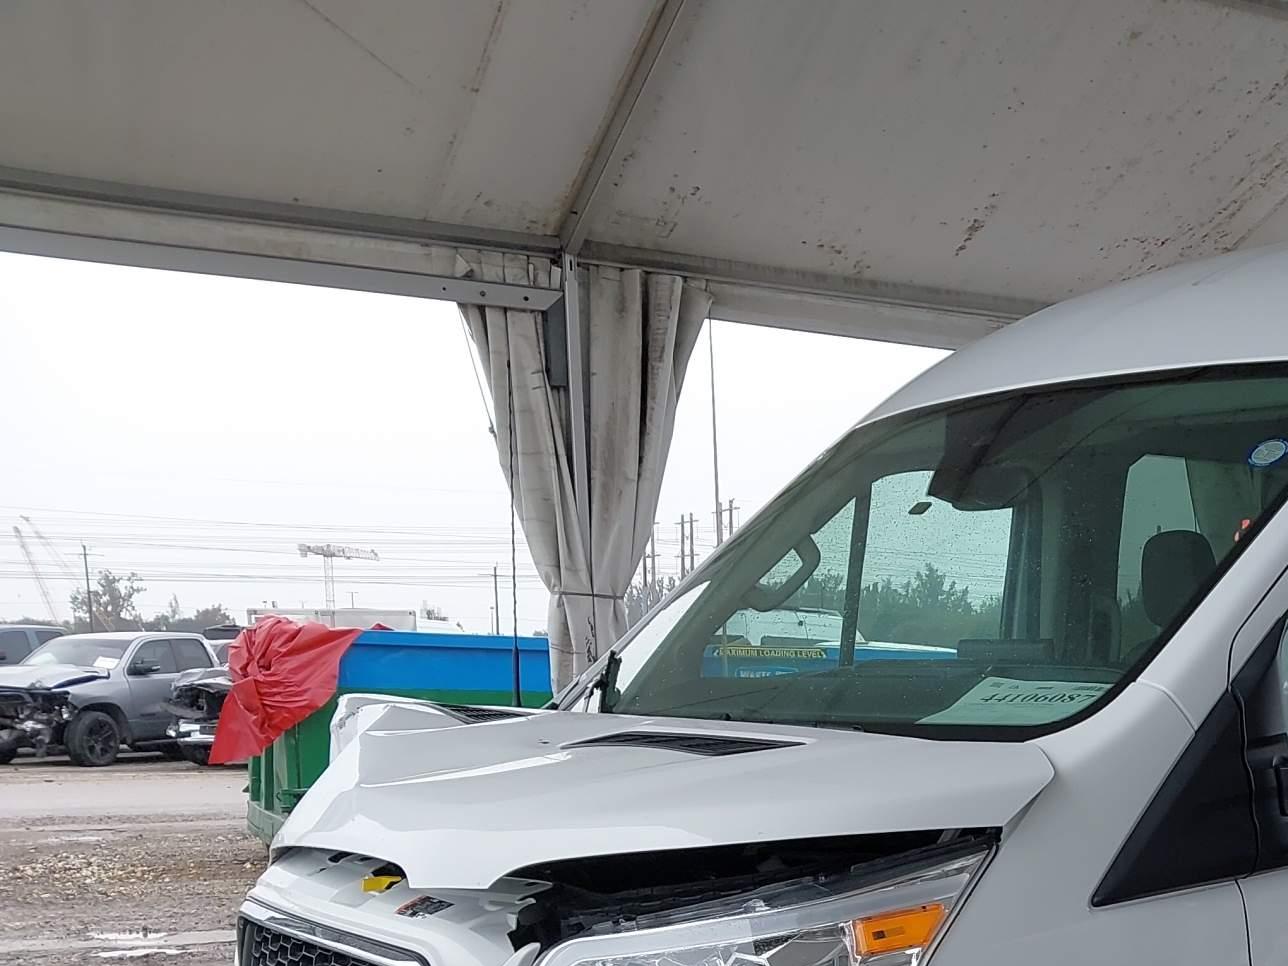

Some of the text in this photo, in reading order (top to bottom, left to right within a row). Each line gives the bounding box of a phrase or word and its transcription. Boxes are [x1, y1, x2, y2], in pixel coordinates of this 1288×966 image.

[719, 648, 822, 659] MAXIMUM LOADING LEVEL
[981, 692, 1096, 703] 44106087
